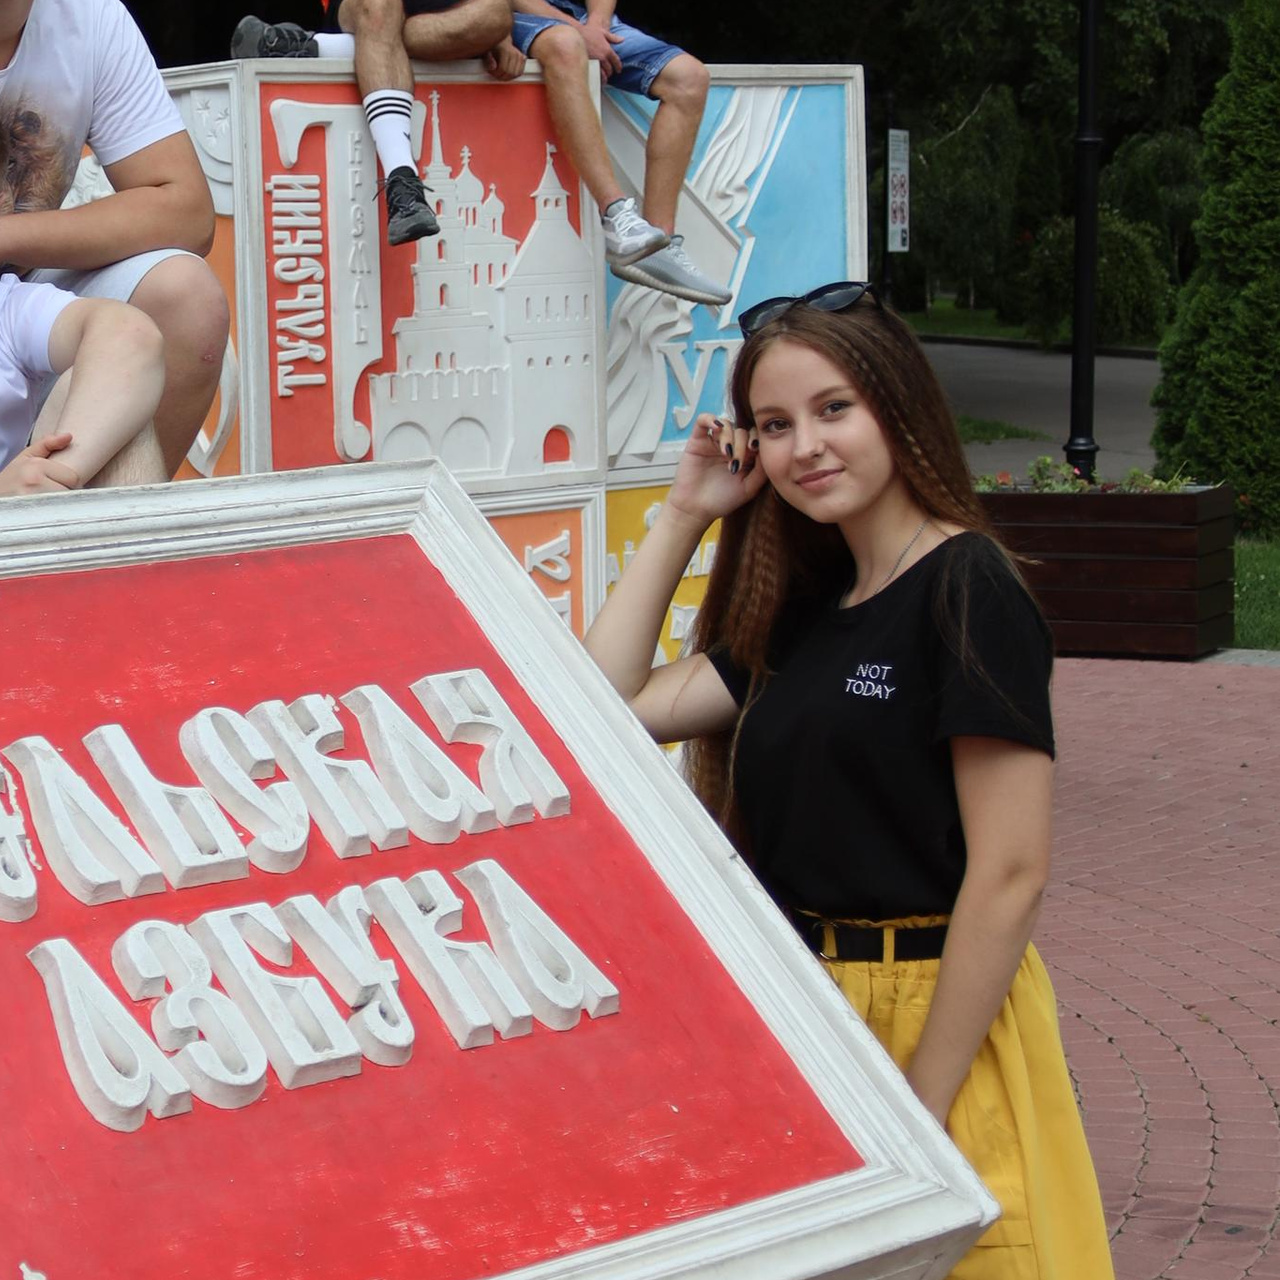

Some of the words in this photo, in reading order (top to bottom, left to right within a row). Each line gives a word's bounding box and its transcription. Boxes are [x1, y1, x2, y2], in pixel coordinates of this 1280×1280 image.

[265, 174, 327, 398] ТУЛЬСКИЙ
[845, 678, 896, 700] TODAY
[856, 663, 892, 681] NOT
[27, 858, 621, 1132] АЗБУКА
